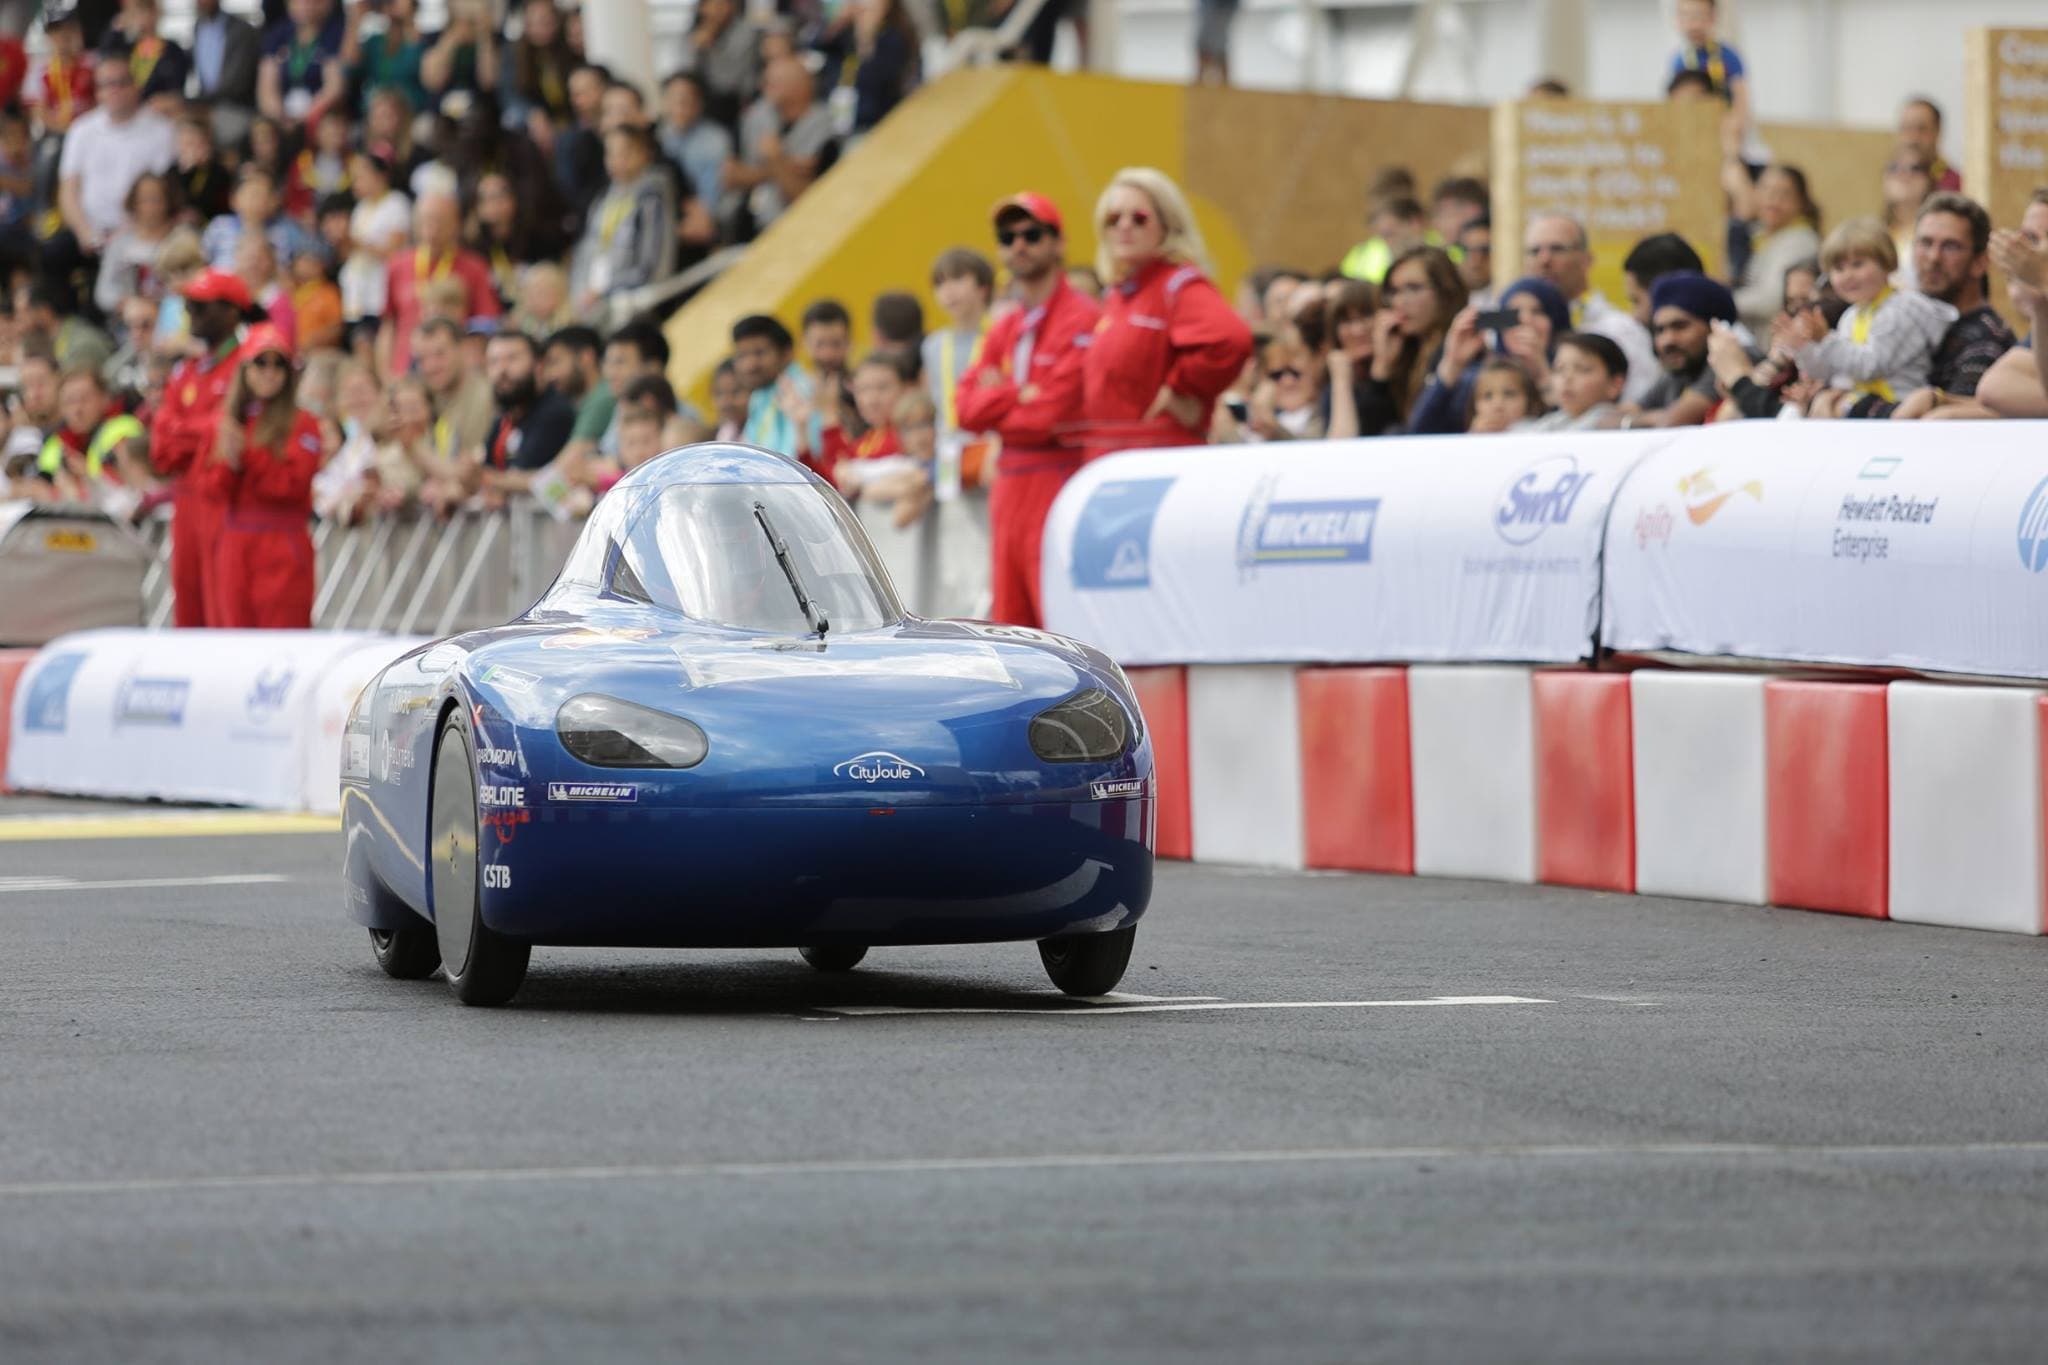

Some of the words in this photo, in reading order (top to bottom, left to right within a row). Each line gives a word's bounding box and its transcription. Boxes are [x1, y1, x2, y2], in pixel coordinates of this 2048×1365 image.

[1837, 493, 1887, 521] Hewlett
[1885, 494, 1940, 524] Packard
[1258, 509, 1377, 547] MICHELIN
[1832, 527, 1889, 564] Enterprise
[480, 785, 525, 807] ABALONE
[569, 786, 632, 798] MICHELIN
[1107, 781, 1141, 793] MICHELIN
[483, 864, 512, 888] CSTB
